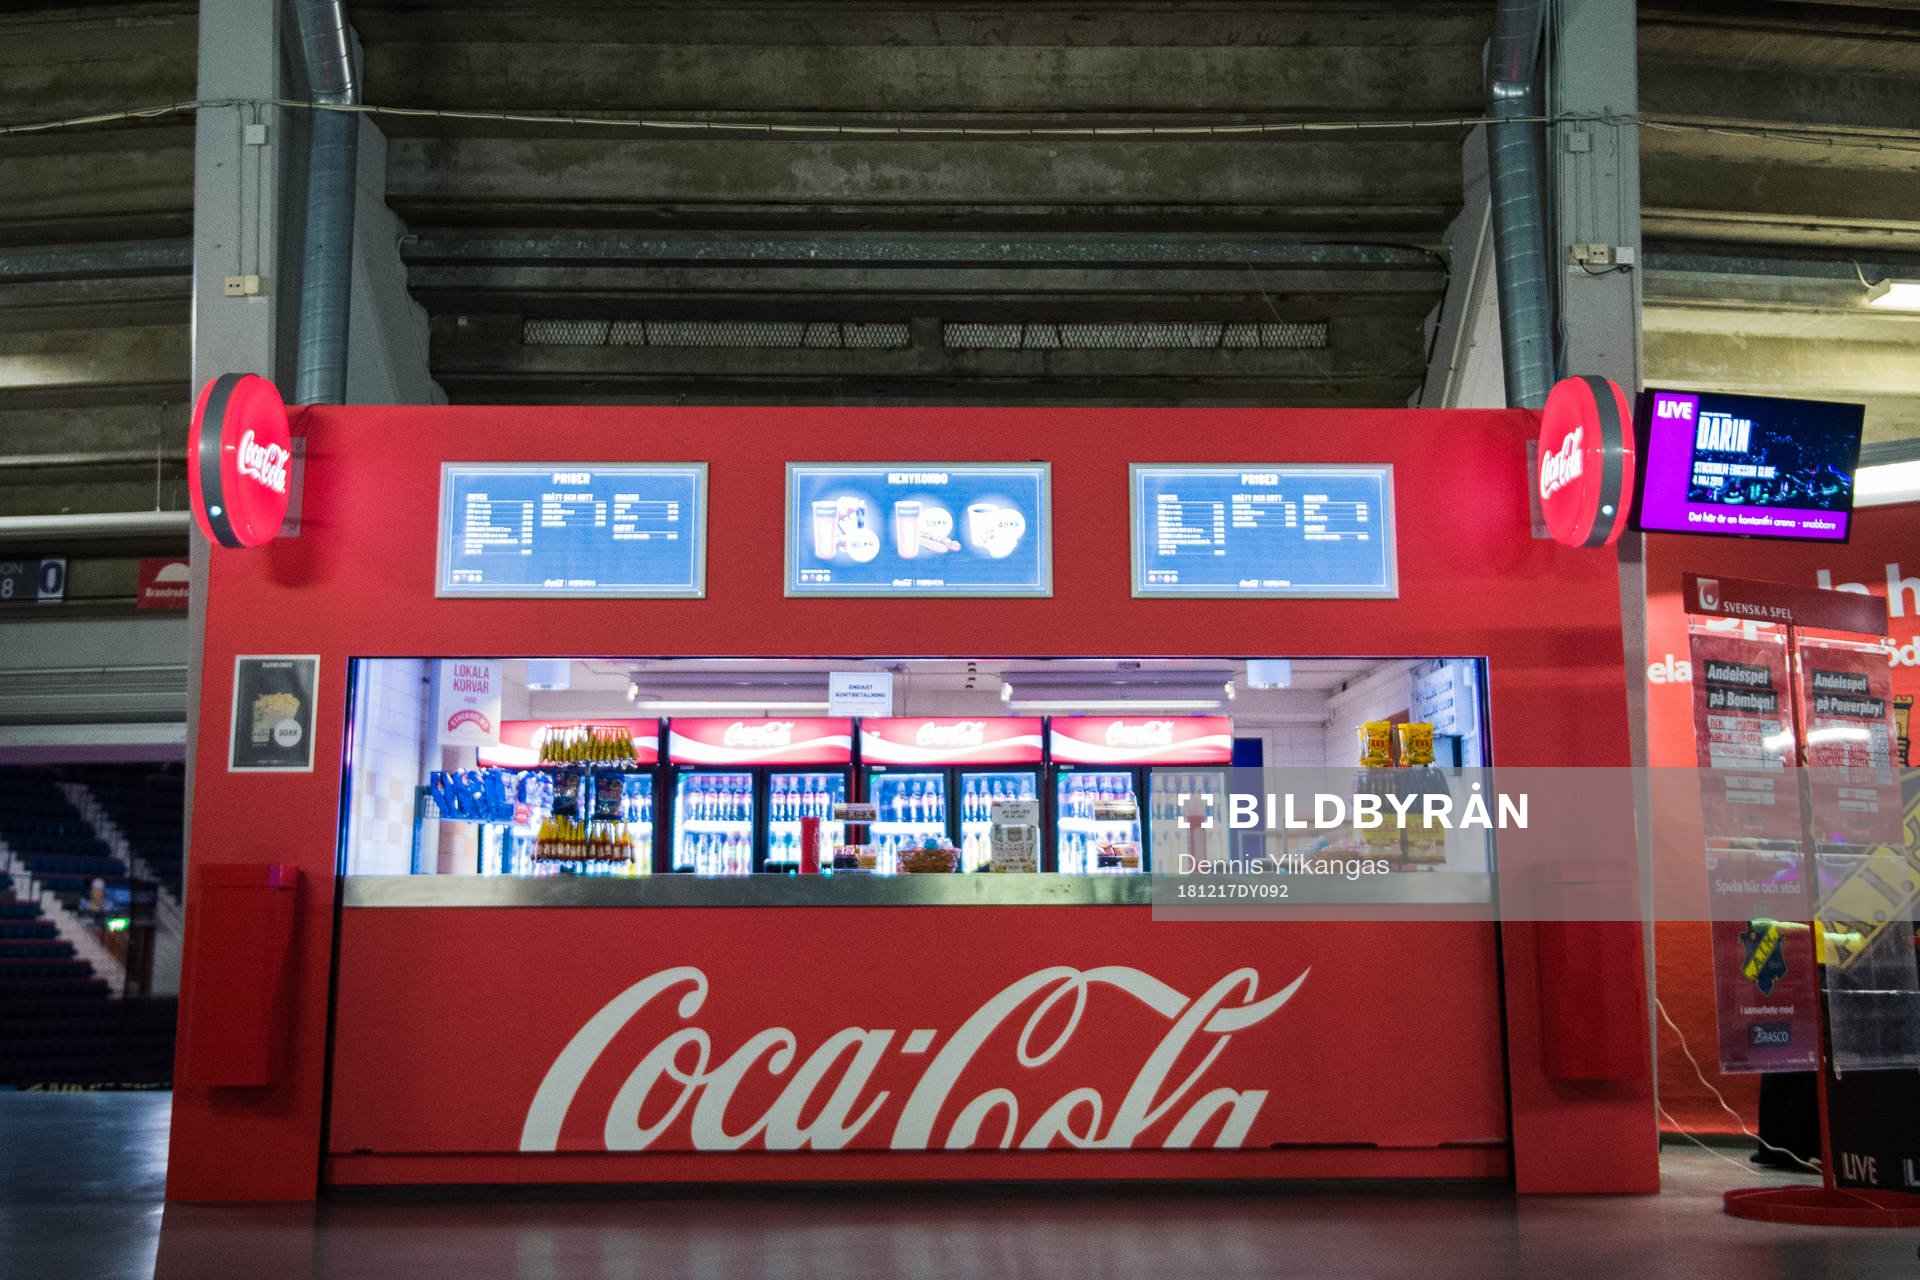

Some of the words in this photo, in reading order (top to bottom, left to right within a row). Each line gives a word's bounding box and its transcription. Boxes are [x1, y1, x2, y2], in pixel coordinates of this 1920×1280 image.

[1657, 400, 1692, 420] LIVE
[1696, 416, 1751, 453] DARIN
[1688, 512, 1702, 523] Det
[1702, 512, 1717, 523] här
[1716, 514, 1727, 524] är
[1727, 516, 1738, 524] en
[1738, 514, 1773, 526] kontantfri
[1774, 519, 1796, 528] arena
[1802, 520, 1837, 530] snabbare
[1723, 600, 1768, 617] SVENSKA
[1769, 605, 1793, 620] SPEL
[453, 663, 490, 680] LOKALA
[1707, 664, 1769, 685] Andelsspel
[453, 678, 489, 695] KORVAR
[1814, 674, 1867, 692] Andelsspel
[1709, 690, 1725, 708] på
[1726, 691, 1775, 711] Bomben!
[1816, 697, 1830, 713] på
[1831, 698, 1884, 718] Powerplay!
[1715, 879, 1743, 895] Spela
[1744, 881, 1760, 893] här
[1761, 882, 1778, 893] och
[1780, 881, 1800, 894] stöd
[1744, 1005, 1778, 1015] samarbete
[1779, 1005, 1794, 1015] med
[519, 965, 1312, 1152] Coca-Cola
[1841, 1152, 1879, 1185] LIVE
